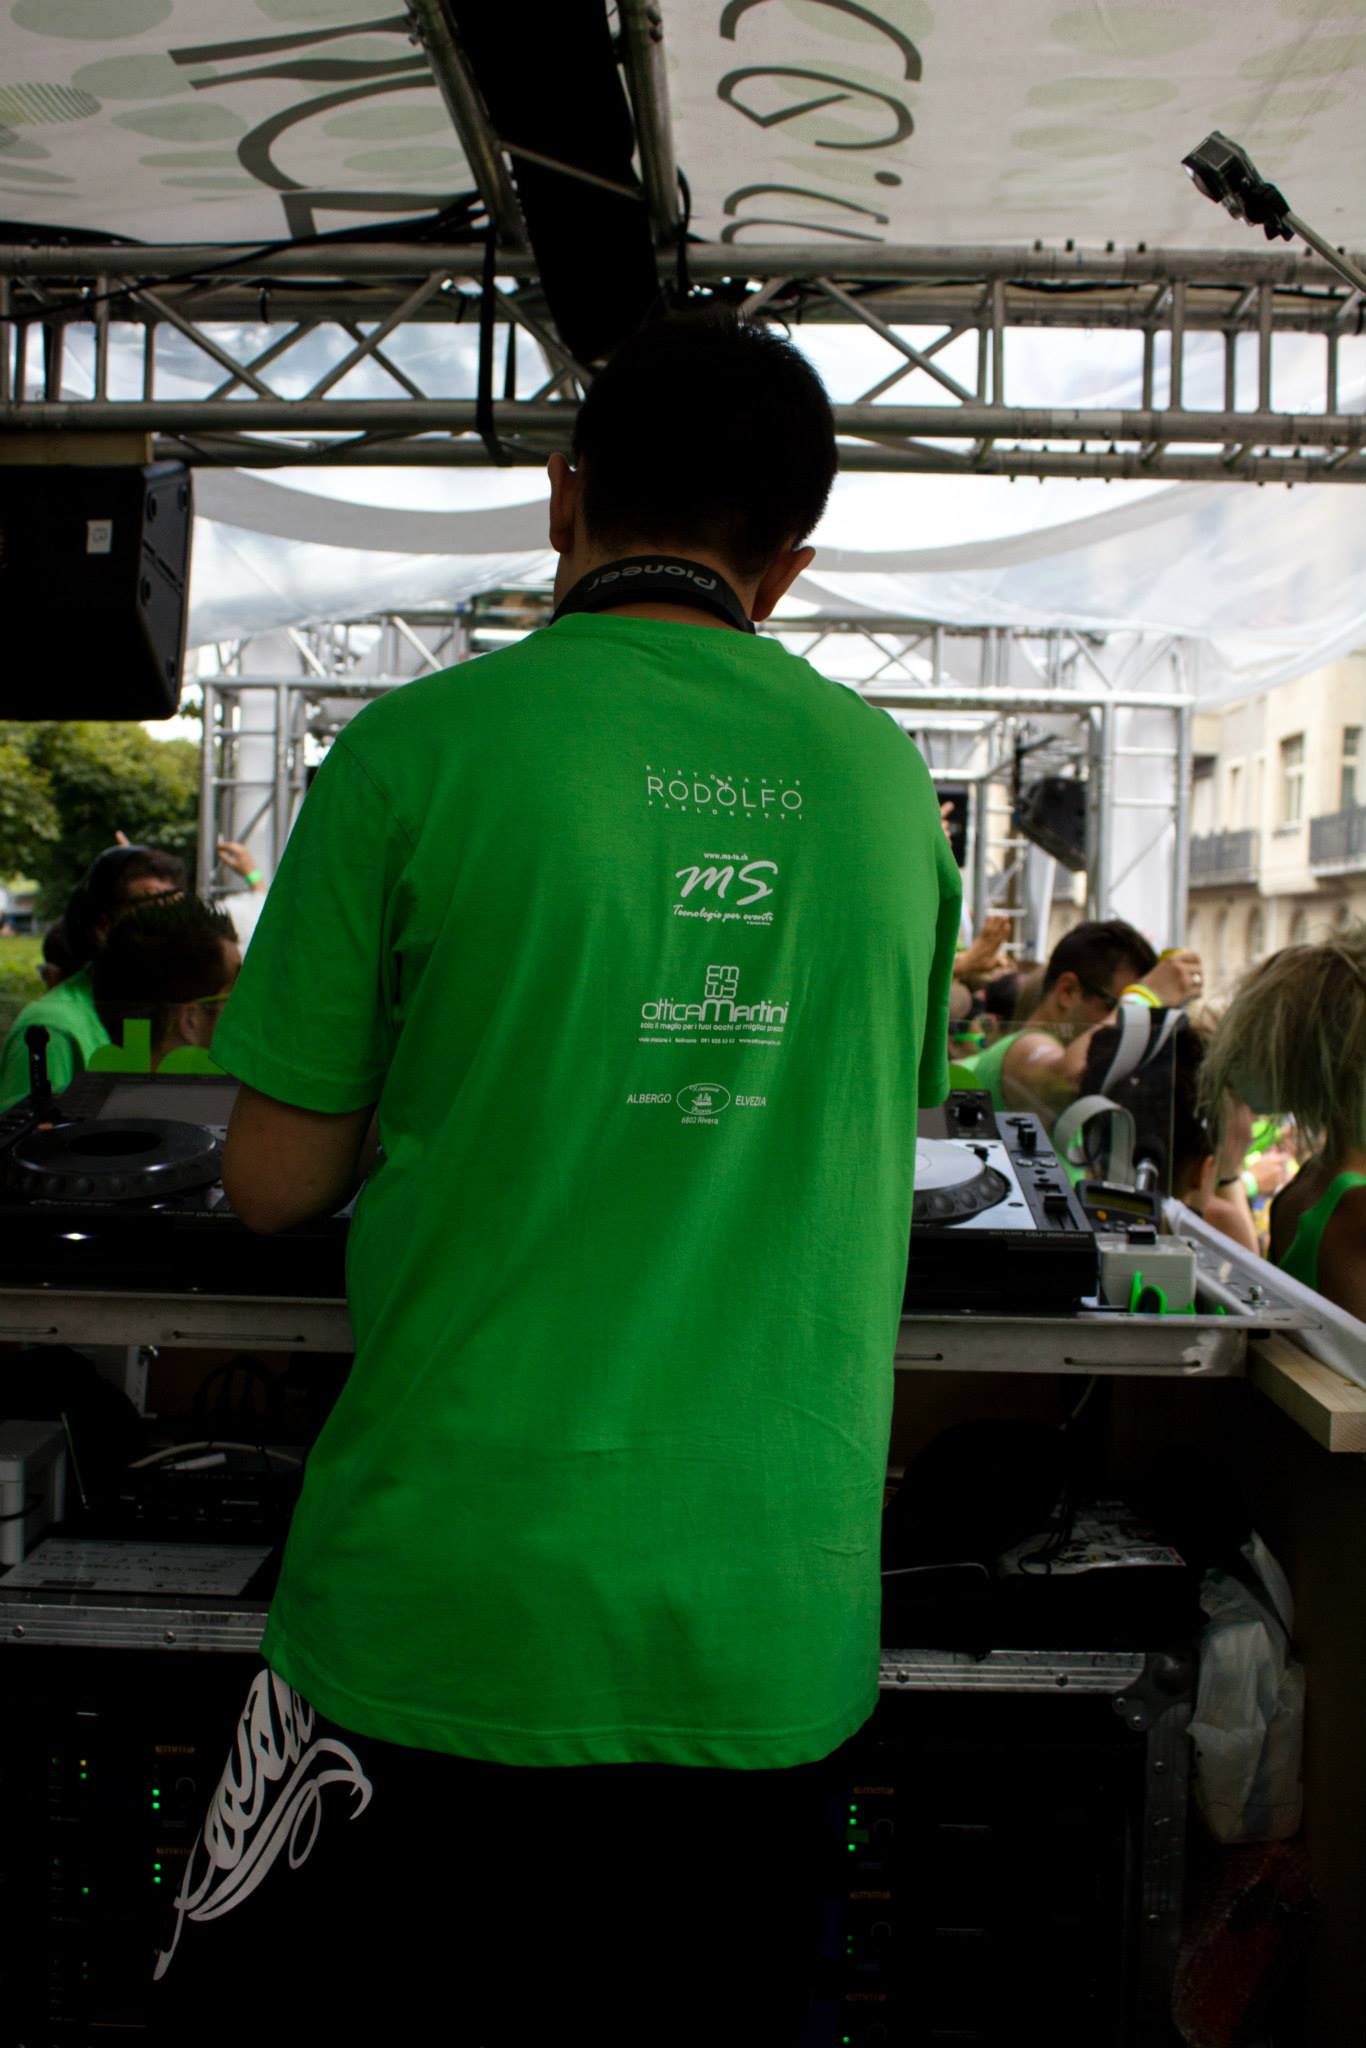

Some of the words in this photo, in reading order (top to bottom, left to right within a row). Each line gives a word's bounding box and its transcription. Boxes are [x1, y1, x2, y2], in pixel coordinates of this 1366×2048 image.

[588, 564, 717, 591] Pioneer
[647, 776, 803, 810] RODOLFO
[722, 911, 741, 922] per
[627, 1093, 672, 1104] ALBERGO
[735, 1095, 768, 1107] ELVEZIA
